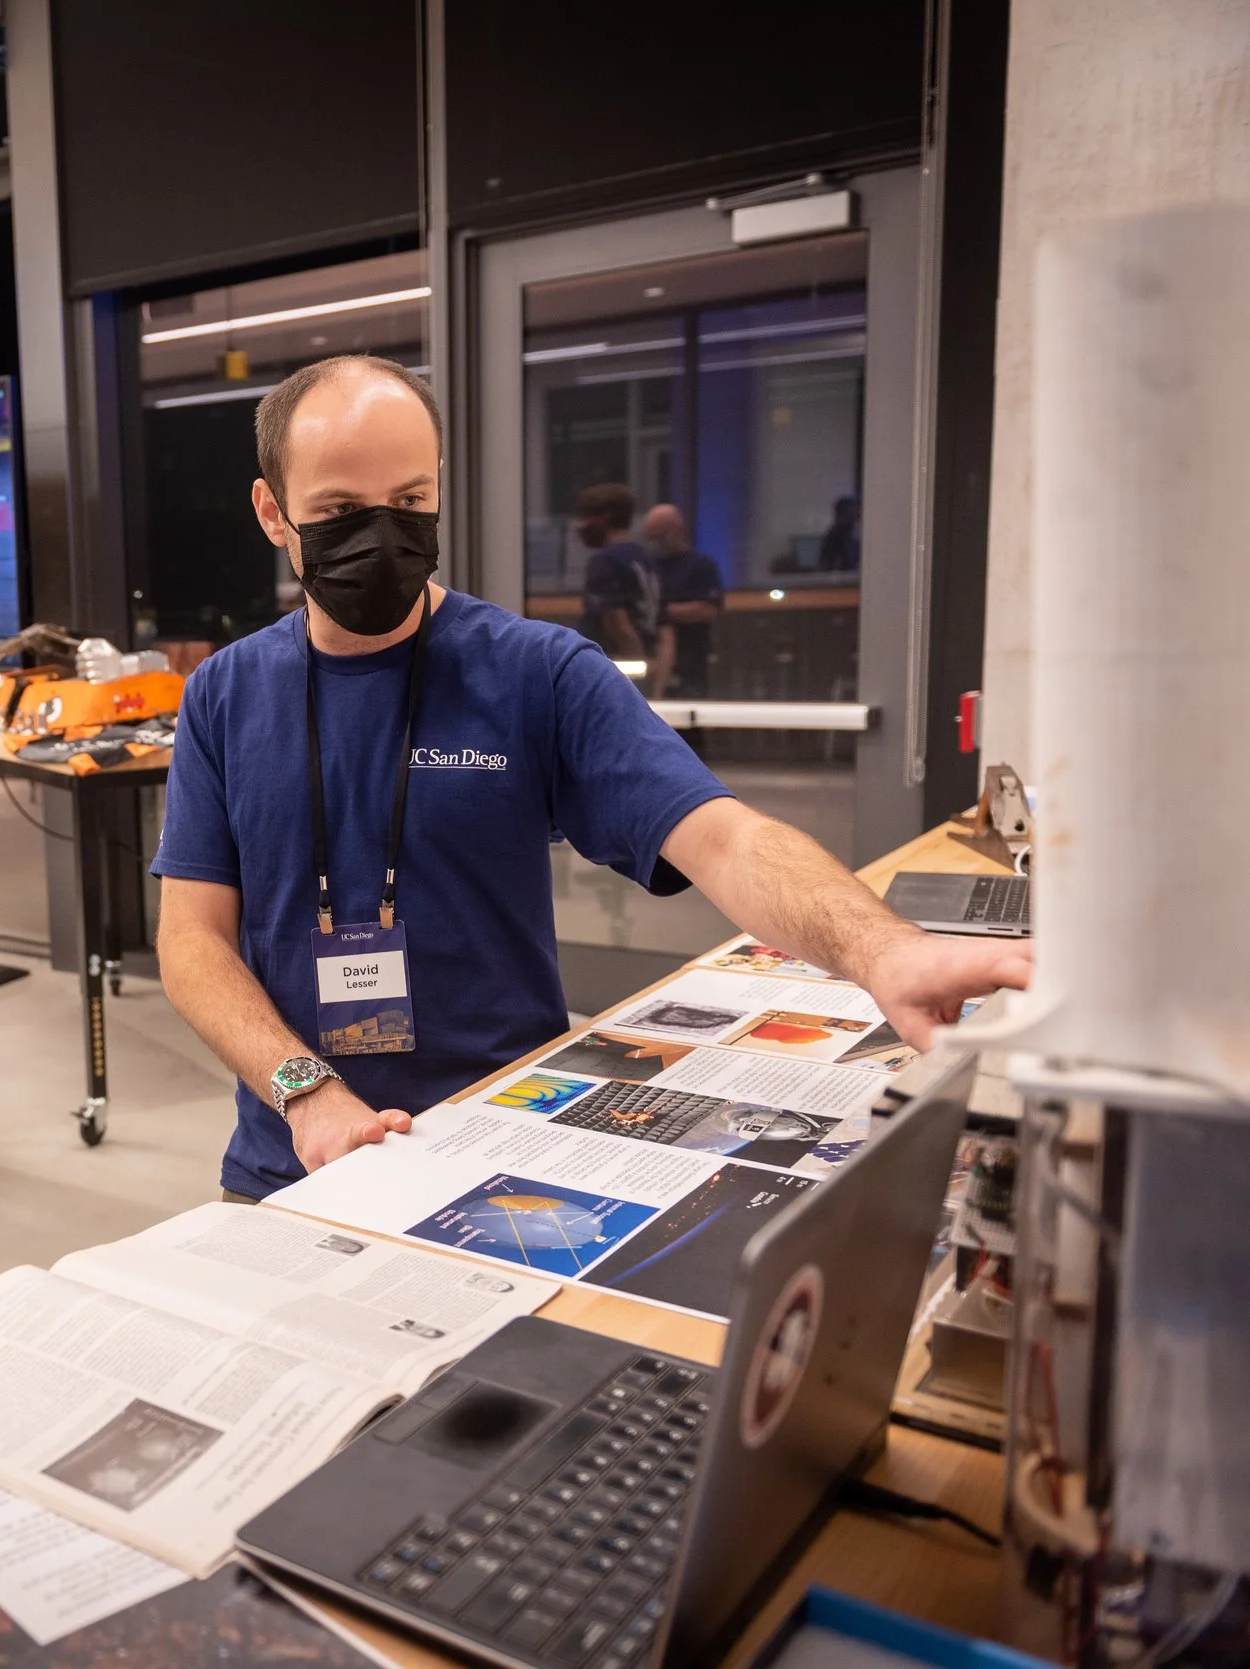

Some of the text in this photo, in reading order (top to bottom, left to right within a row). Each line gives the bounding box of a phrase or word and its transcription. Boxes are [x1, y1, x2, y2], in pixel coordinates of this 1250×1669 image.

[429, 749, 458, 765] San
[461, 749, 507, 770] Diego
[343, 964, 379, 977] David
[346, 980, 378, 989] Lesser
